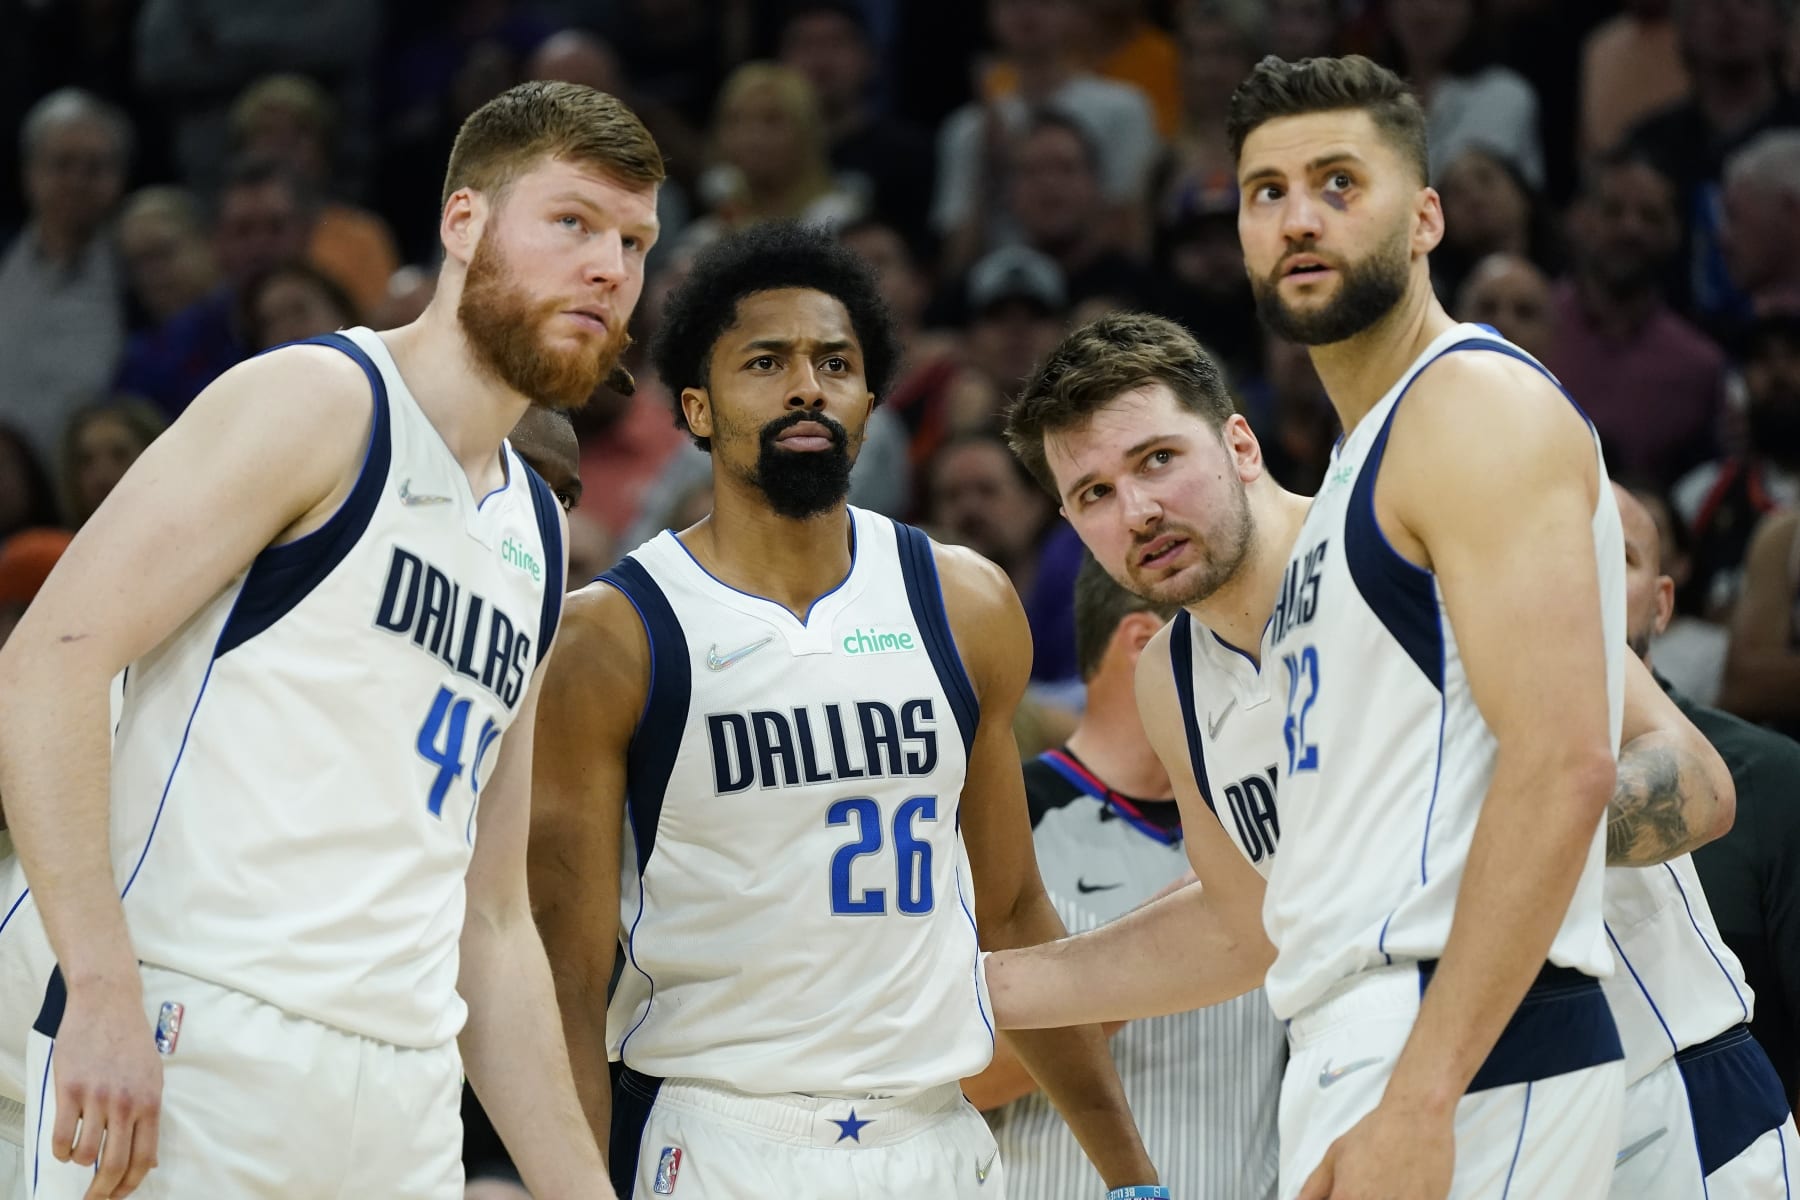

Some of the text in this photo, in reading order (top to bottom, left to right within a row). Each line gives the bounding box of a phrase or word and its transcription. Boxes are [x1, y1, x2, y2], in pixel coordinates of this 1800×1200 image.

[502, 537, 540, 581] chime
[372, 544, 530, 712] DALLAS
[843, 629, 914, 654] chime
[705, 697, 938, 797] DALLAS
[825, 795, 938, 916] 26
